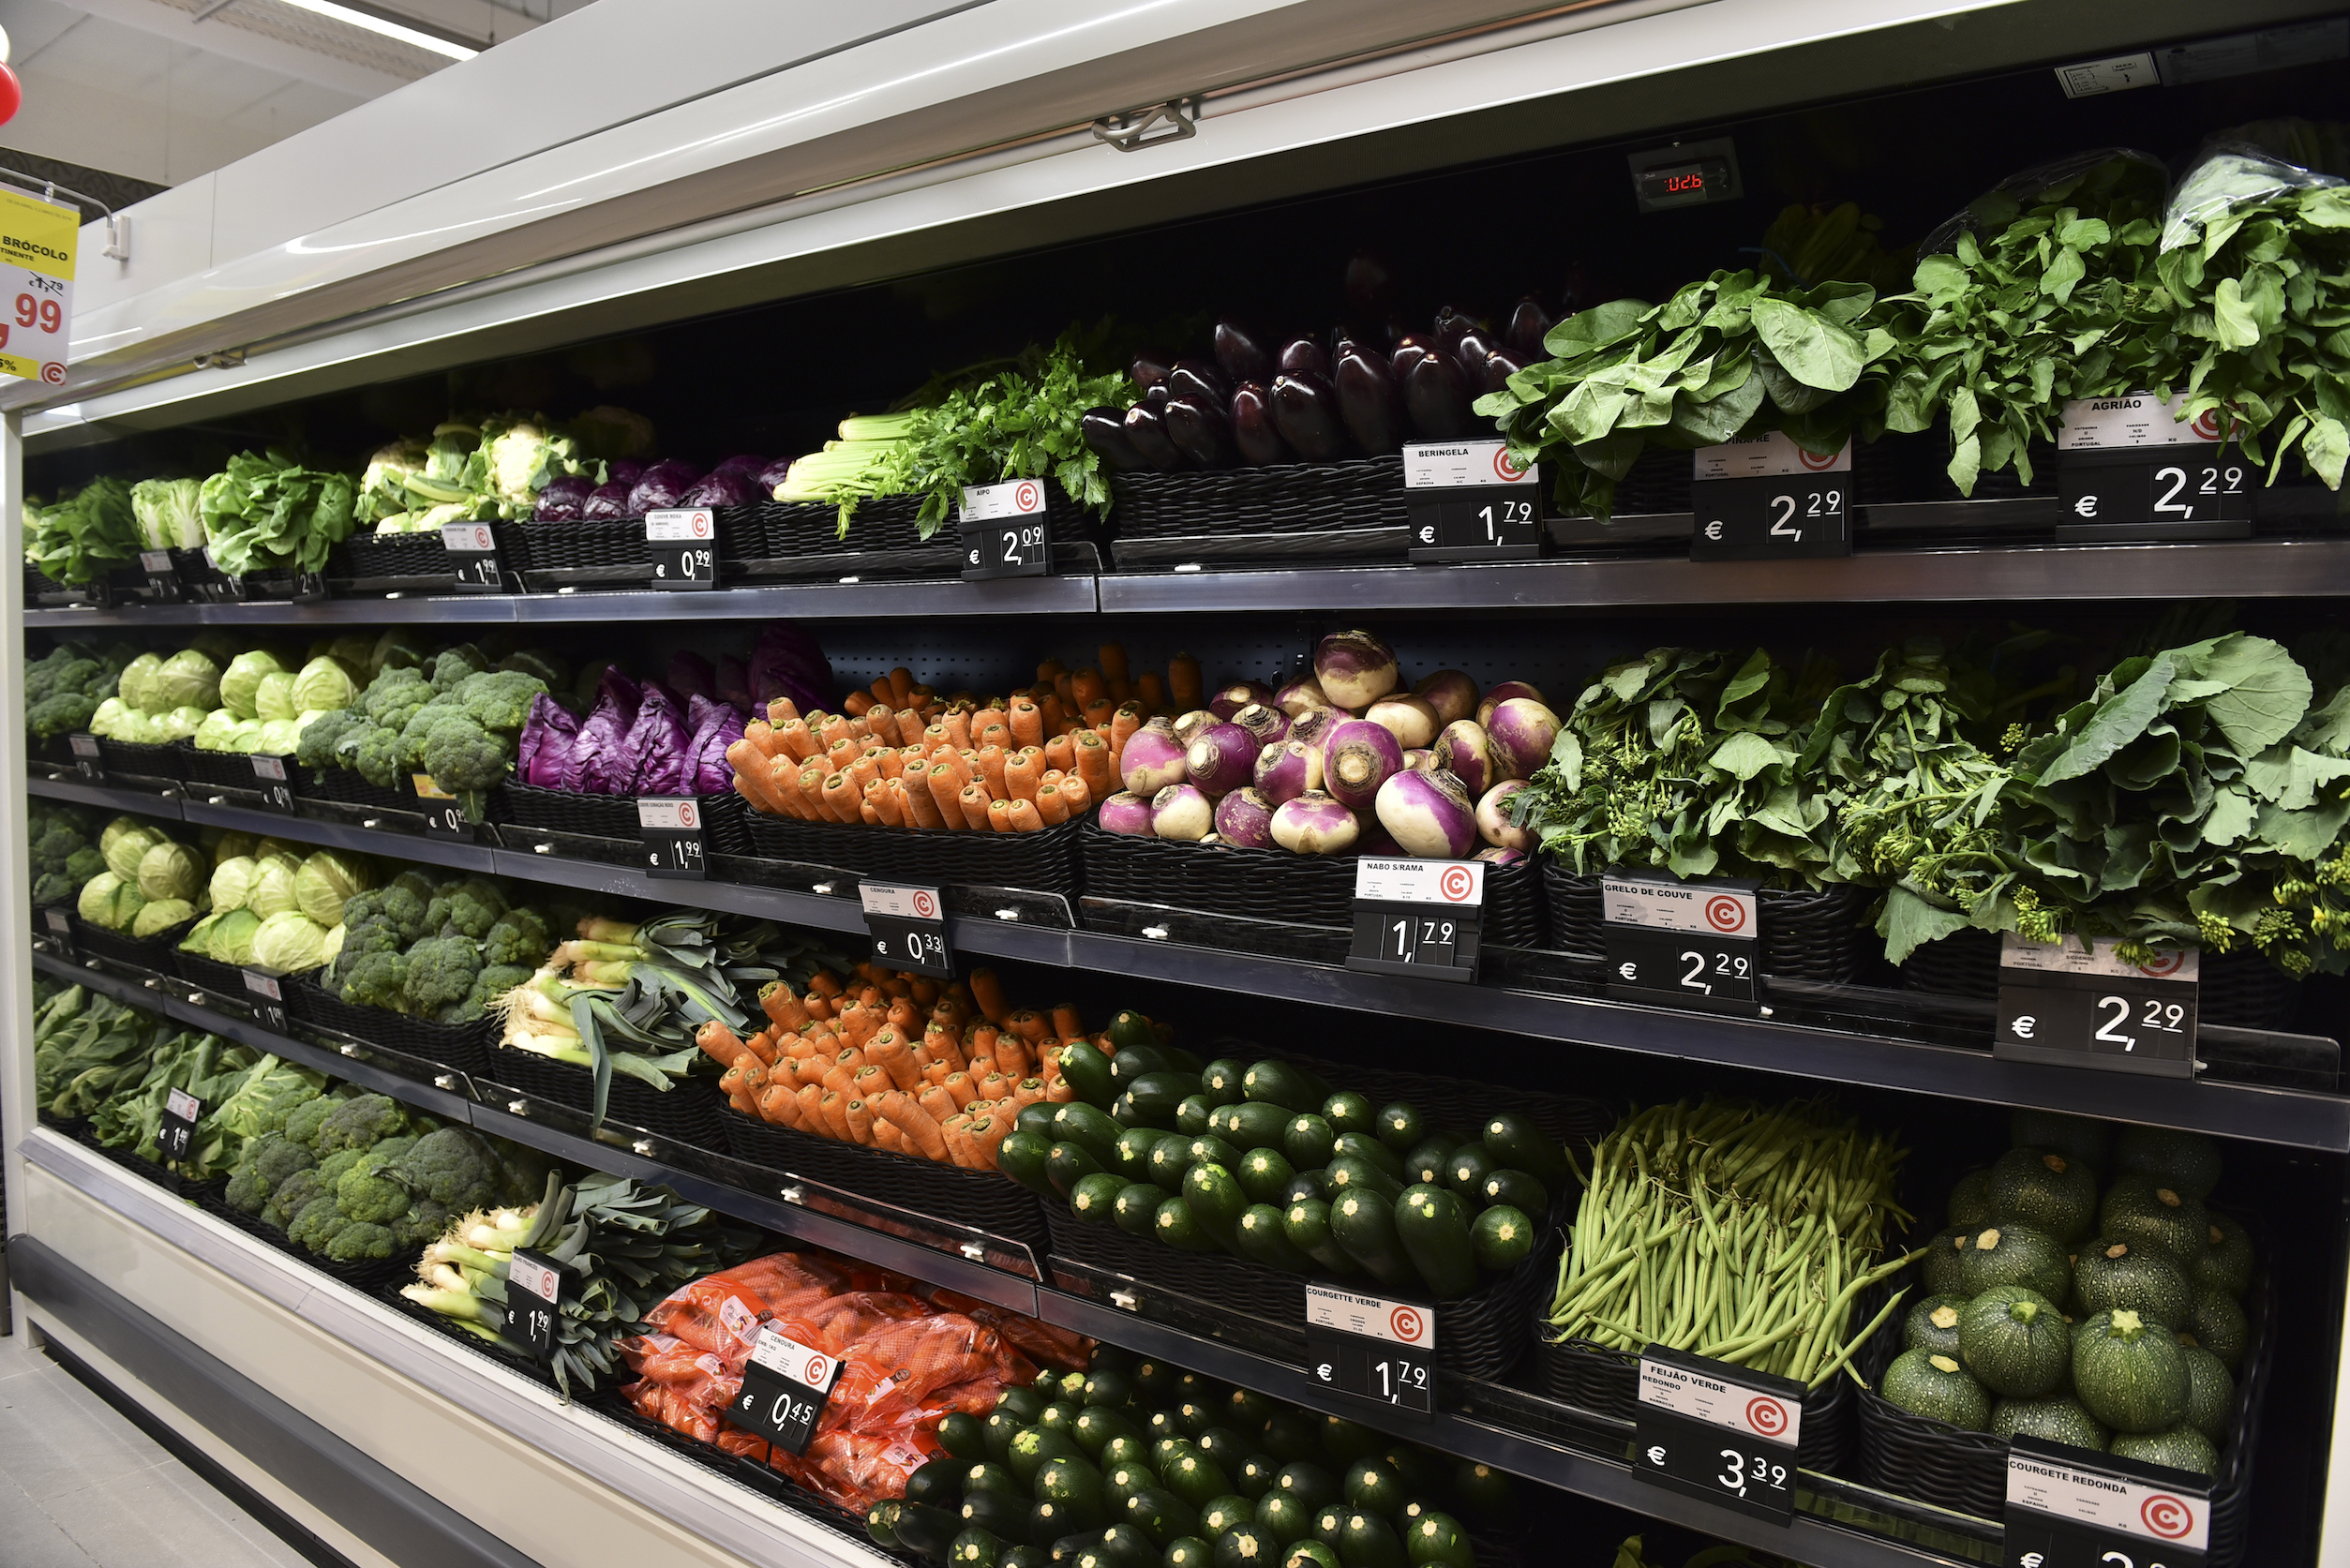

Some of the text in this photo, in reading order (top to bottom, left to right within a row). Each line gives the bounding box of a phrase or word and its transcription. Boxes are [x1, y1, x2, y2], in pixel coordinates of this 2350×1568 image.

[3, 235, 67, 261] BRÓCOLO
[35, 276, 64, 293] 1,79
[2091, 398, 2142, 411] AGRIÃO
[1418, 448, 1469, 457] BERINGELA
[976, 488, 991, 497] AIPO
[2074, 466, 2243, 519] € 2,29
[1418, 500, 1534, 546] € 1,79
[1704, 490, 1841, 543] € 2,29
[968, 526, 1042, 566] € 2,09
[474, 558, 497, 586] 1,99
[656, 549, 711, 581] € 0,99
[650, 840, 701, 870] € 1,99
[1367, 862, 1424, 872] NABO S/RAMA
[1604, 884, 1693, 900] GRELO DE COUVE
[876, 932, 943, 965] € 0,33
[1392, 919, 1454, 963] 1,79
[1618, 950, 1751, 995] € 2,29
[2012, 995, 2185, 1053] € 2,29
[1307, 1288, 1382, 1308] COURGETTE VERDE
[508, 1309, 549, 1342] € 1,99
[770, 1335, 796, 1351] CENOURA
[1316, 1360, 1427, 1404] € 1,79
[1642, 1375, 1682, 1391] REDONDO
[1651, 1365, 1688, 1383] FEIJÃO
[1691, 1377, 1727, 1394] VERDE
[741, 1393, 814, 1432] € 0,45
[1647, 1445, 1787, 1498] € 3,39
[2009, 1459, 2128, 1496] COURGETE REDONDA
